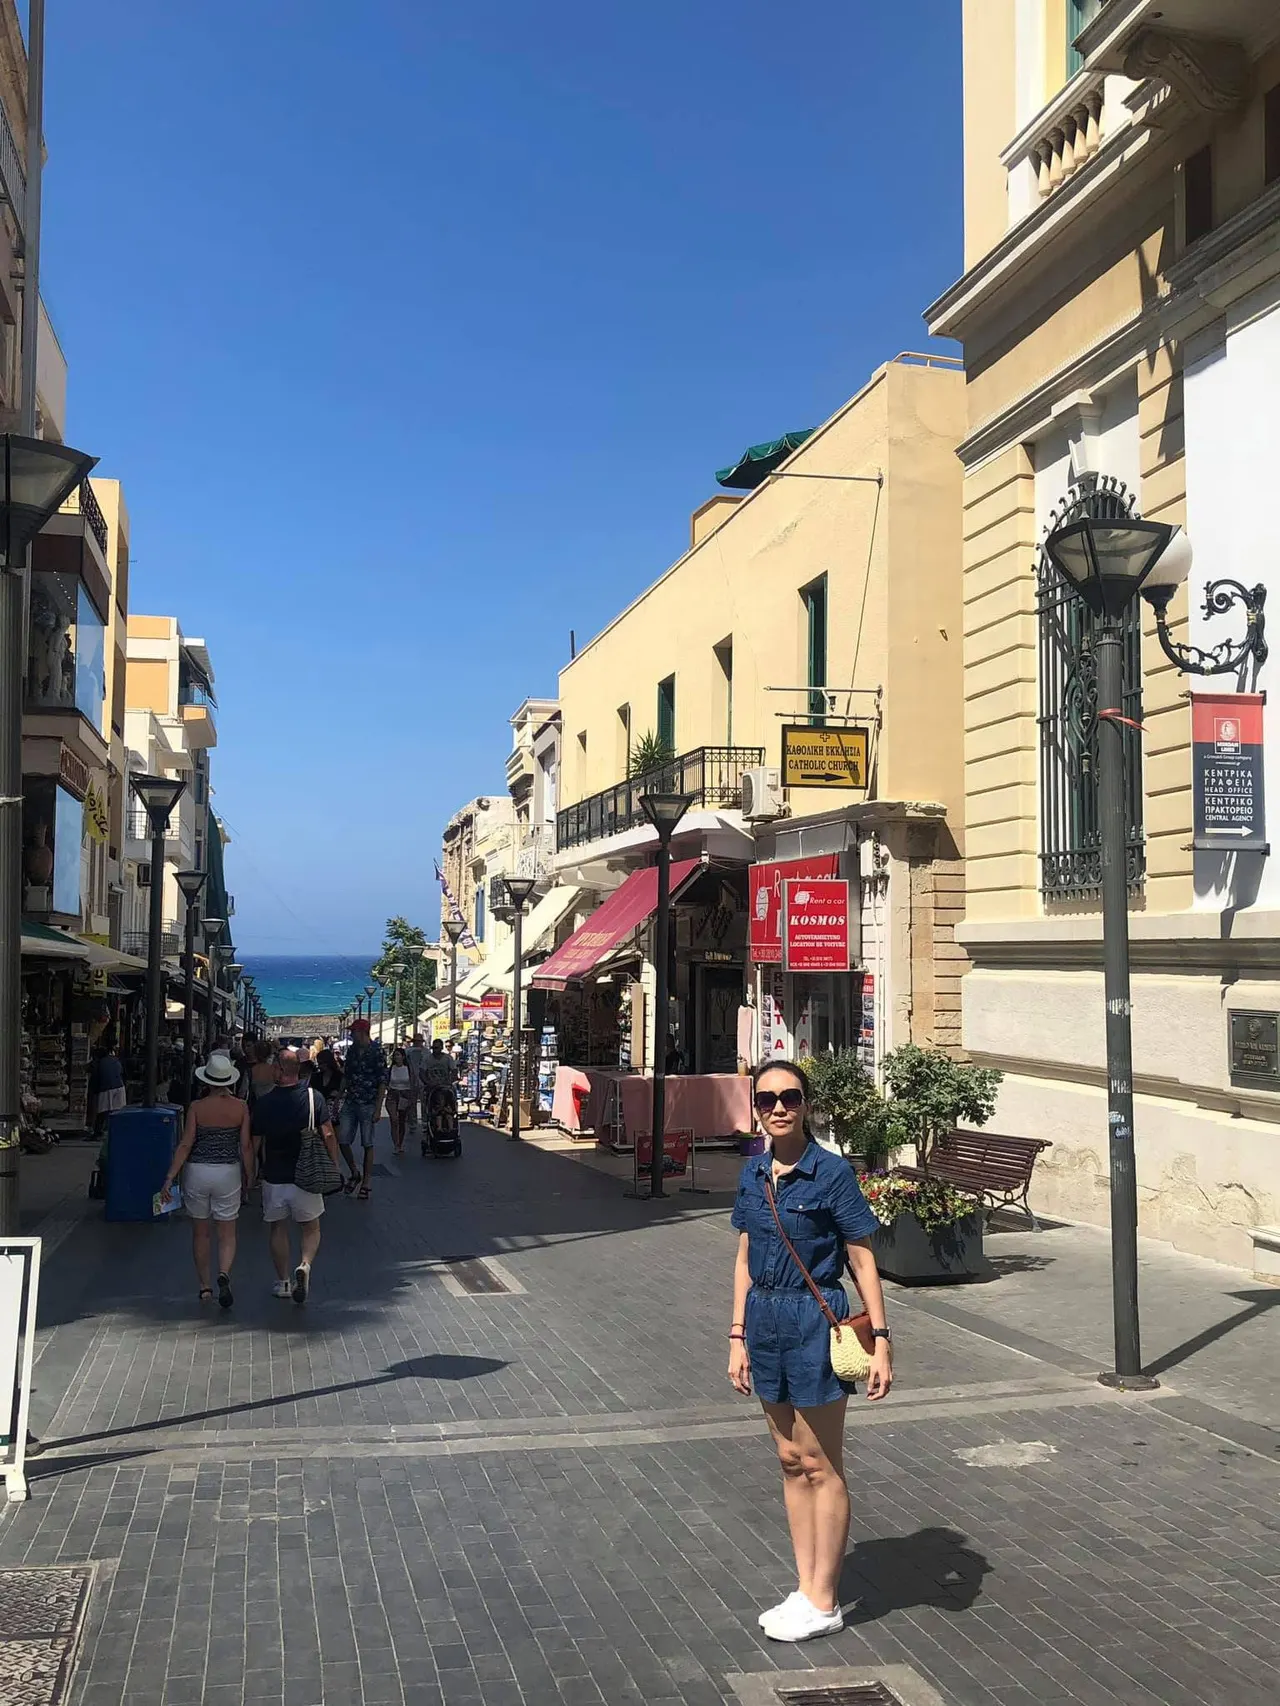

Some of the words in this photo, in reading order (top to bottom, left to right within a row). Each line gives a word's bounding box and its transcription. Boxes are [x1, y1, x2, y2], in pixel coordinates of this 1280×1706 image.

[786, 745, 824, 756] ΚΑΘΟΛΙΚΗ
[826, 746, 861, 757] ΕΚΚΛΗΣΙΑ
[788, 760, 826, 770] CATHOLIC
[828, 761, 859, 771] CHURCH
[1204, 769, 1253, 778] ΚΕΝΤΡΙΚΑ
[1204, 778, 1253, 787] ΓΡΑΦΕΙΑ
[1204, 797, 1253, 806] ΚΕΝΤΡΙΚΟ
[1204, 806, 1253, 815] ΠΡΑΚΤΟΡΕΙΟ
[790, 915, 846, 926] KOSMOS
